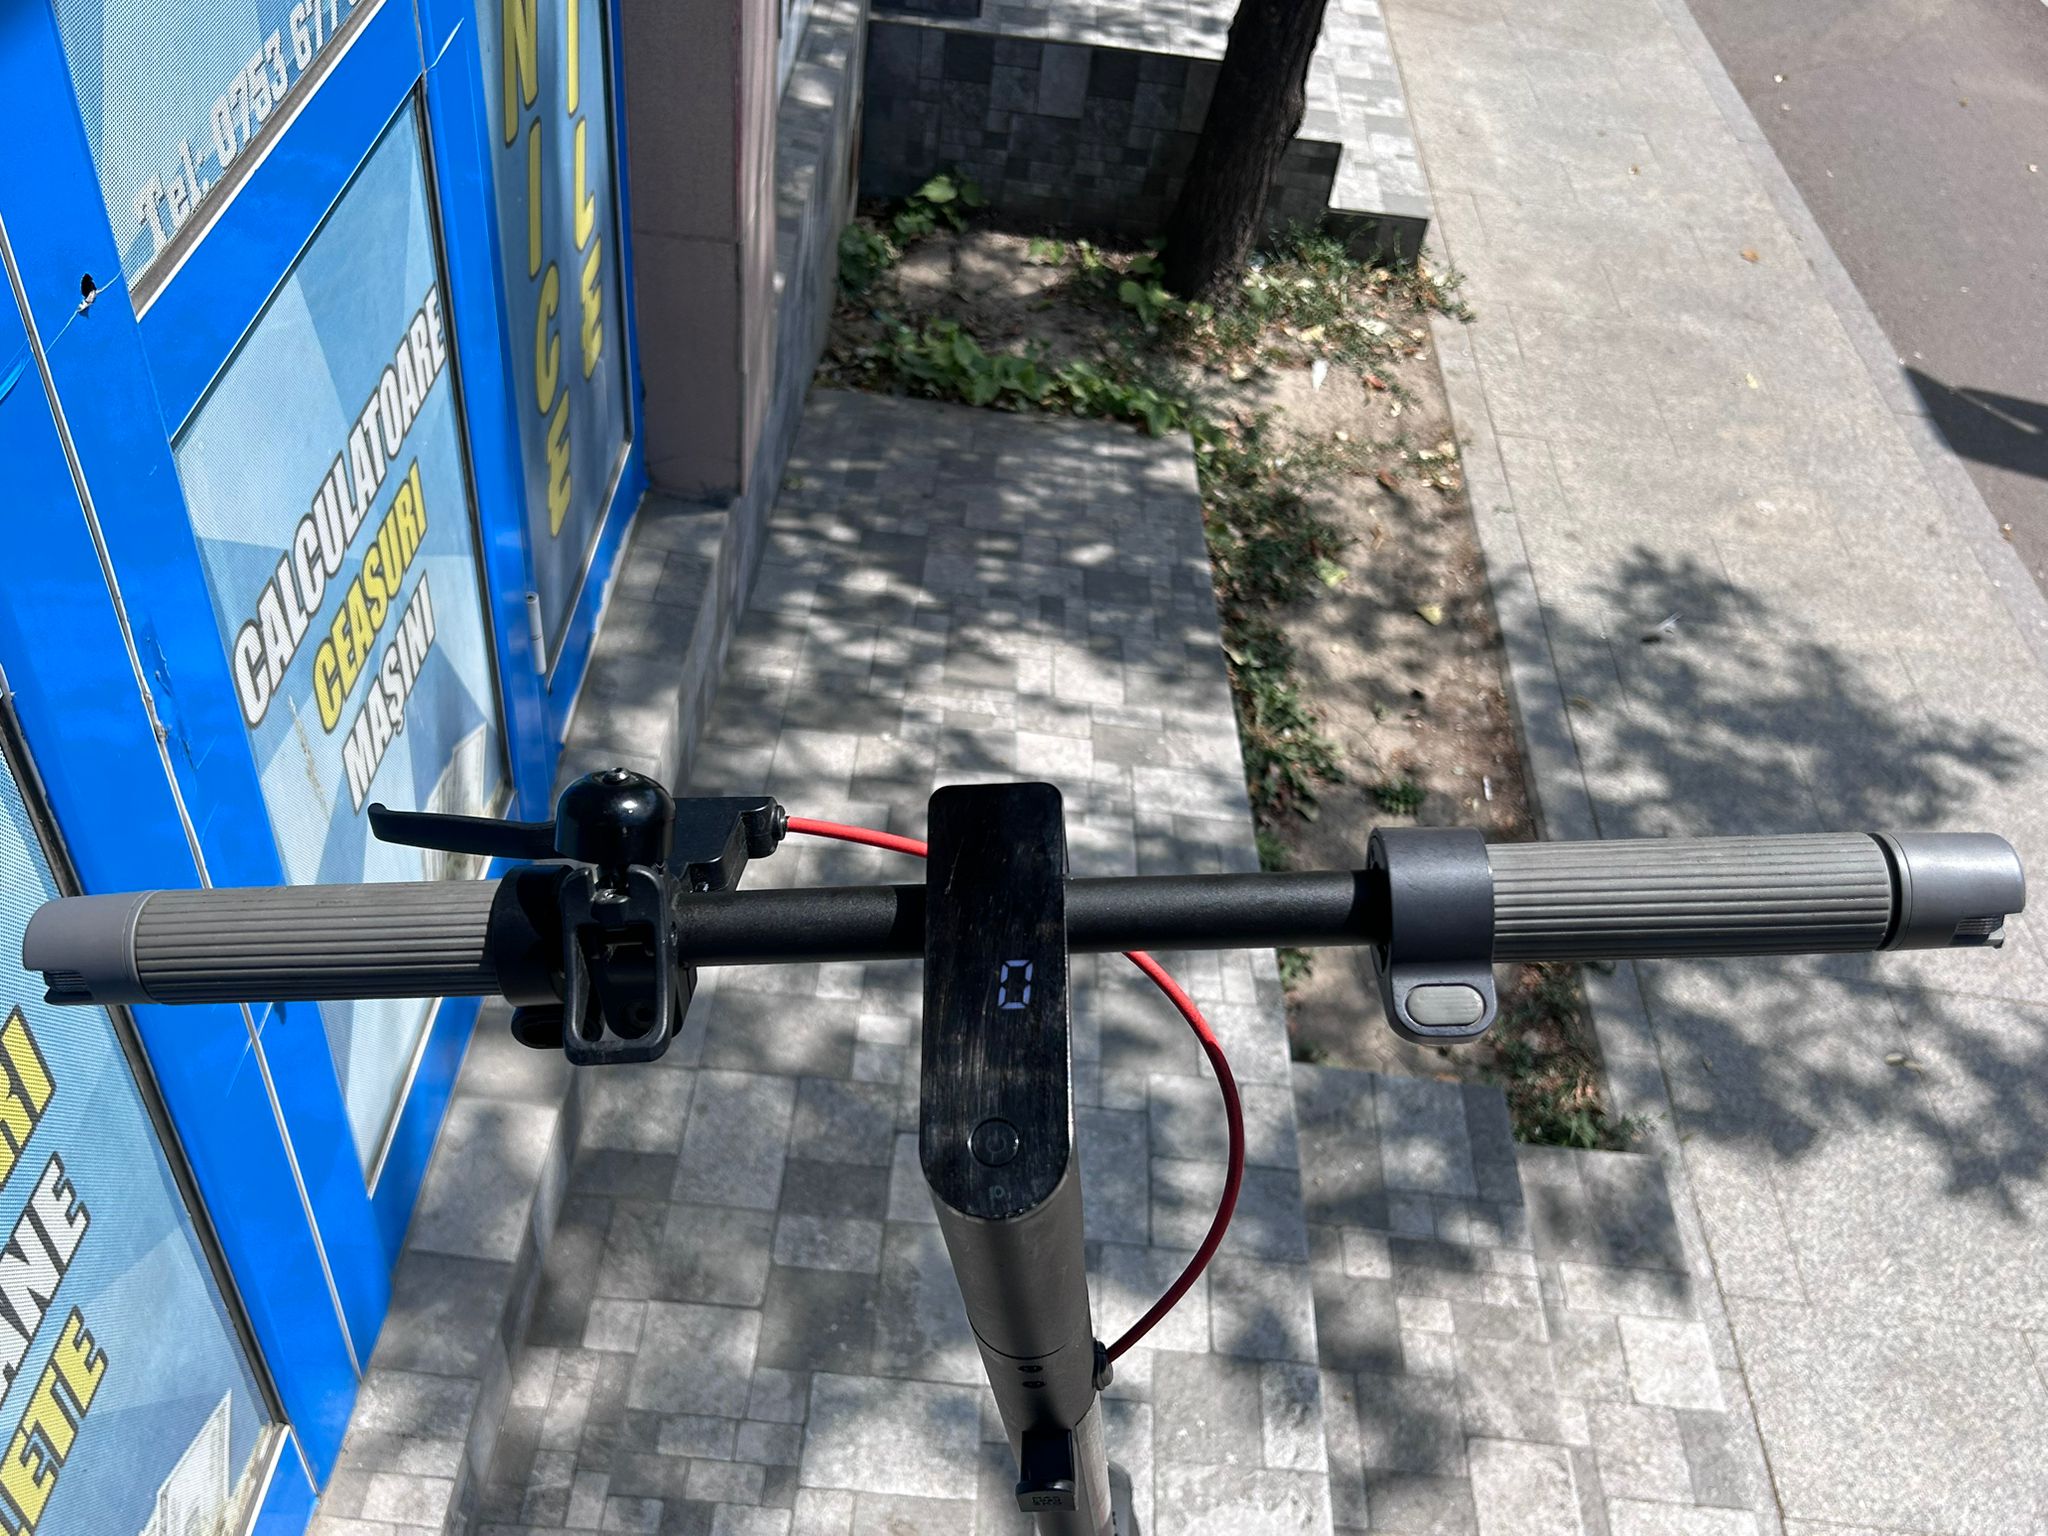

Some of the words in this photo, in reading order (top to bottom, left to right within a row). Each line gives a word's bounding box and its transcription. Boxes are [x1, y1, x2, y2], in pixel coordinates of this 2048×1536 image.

[210, 26, 289, 170] 0753
[233, 283, 447, 730] CALCULATOARE
[313, 457, 428, 734] CEASURI
[998, 959, 1033, 1010] 0
[0, 1304, 109, 1536] ETE
